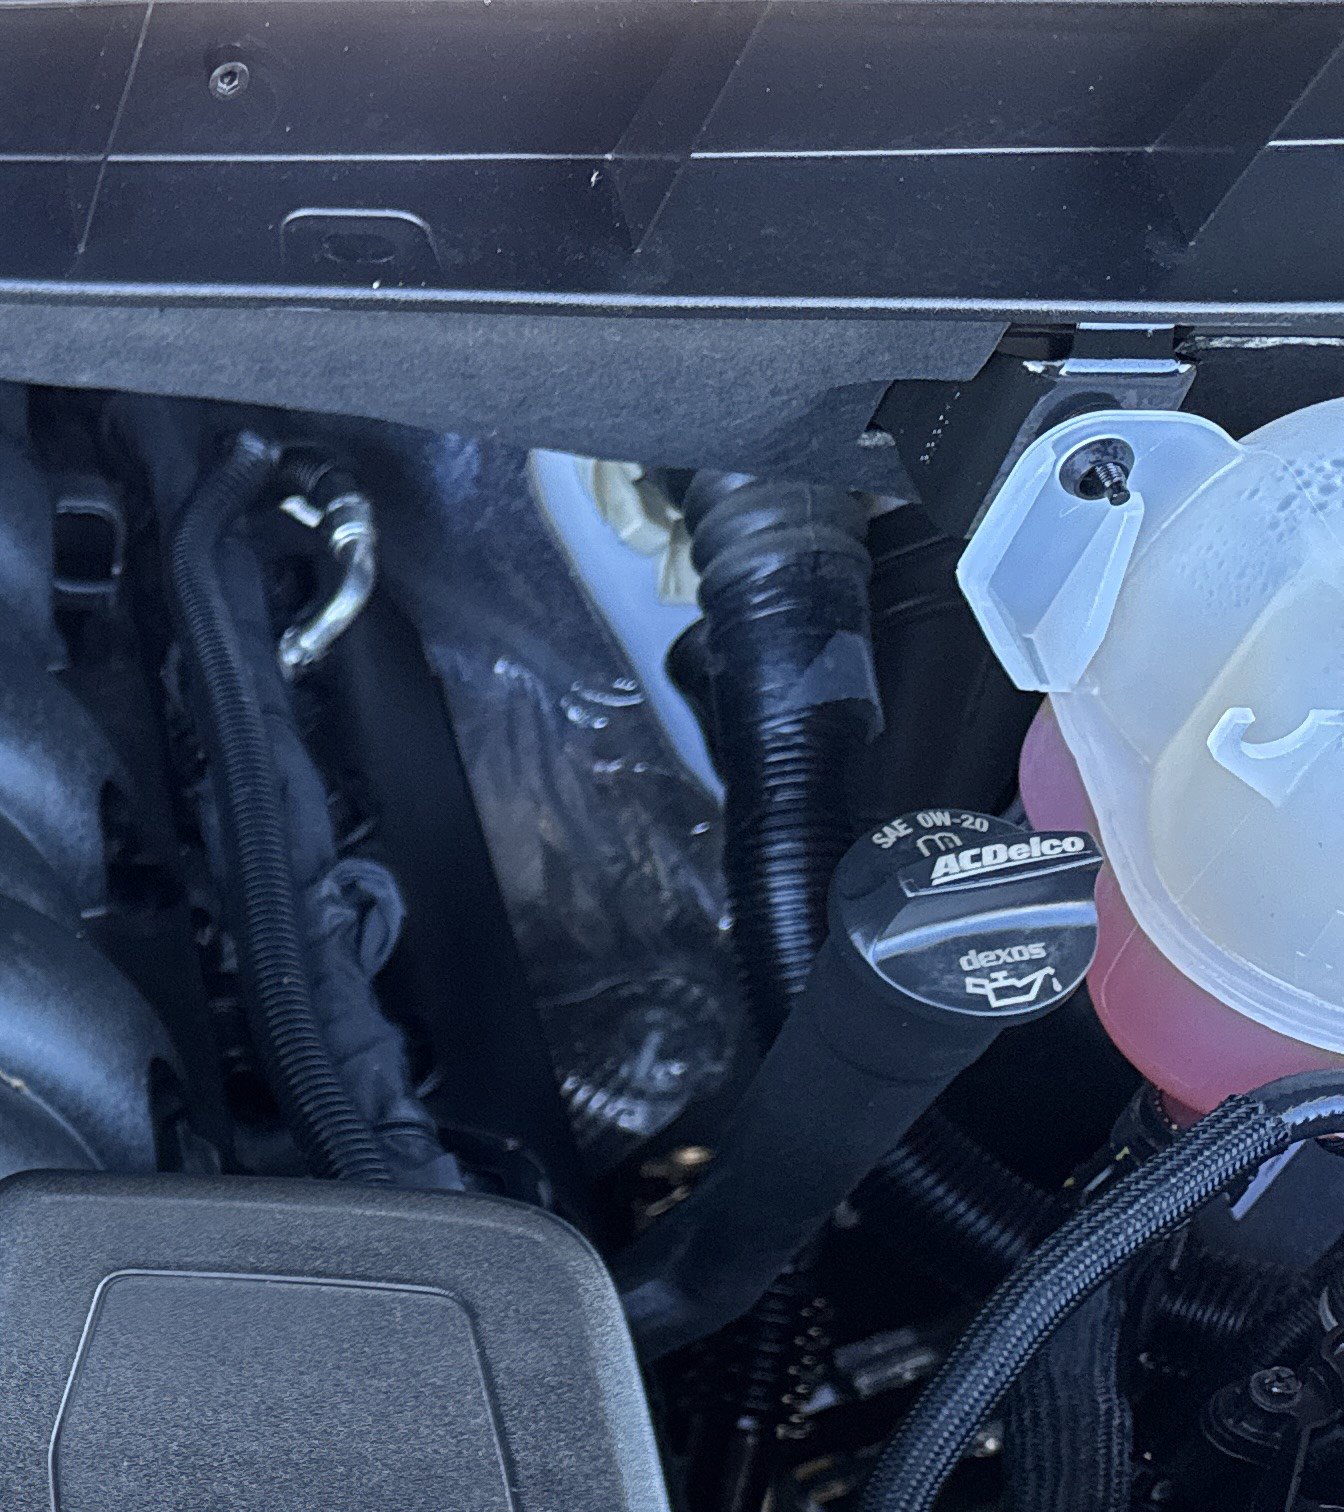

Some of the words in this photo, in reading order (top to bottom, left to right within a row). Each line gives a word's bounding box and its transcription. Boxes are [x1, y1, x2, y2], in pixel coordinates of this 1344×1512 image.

[872, 818, 913, 849] SAE
[916, 811, 989, 833] 0W-20
[930, 836, 1085, 880] ACDelco
[959, 942, 1046, 971] dexos
